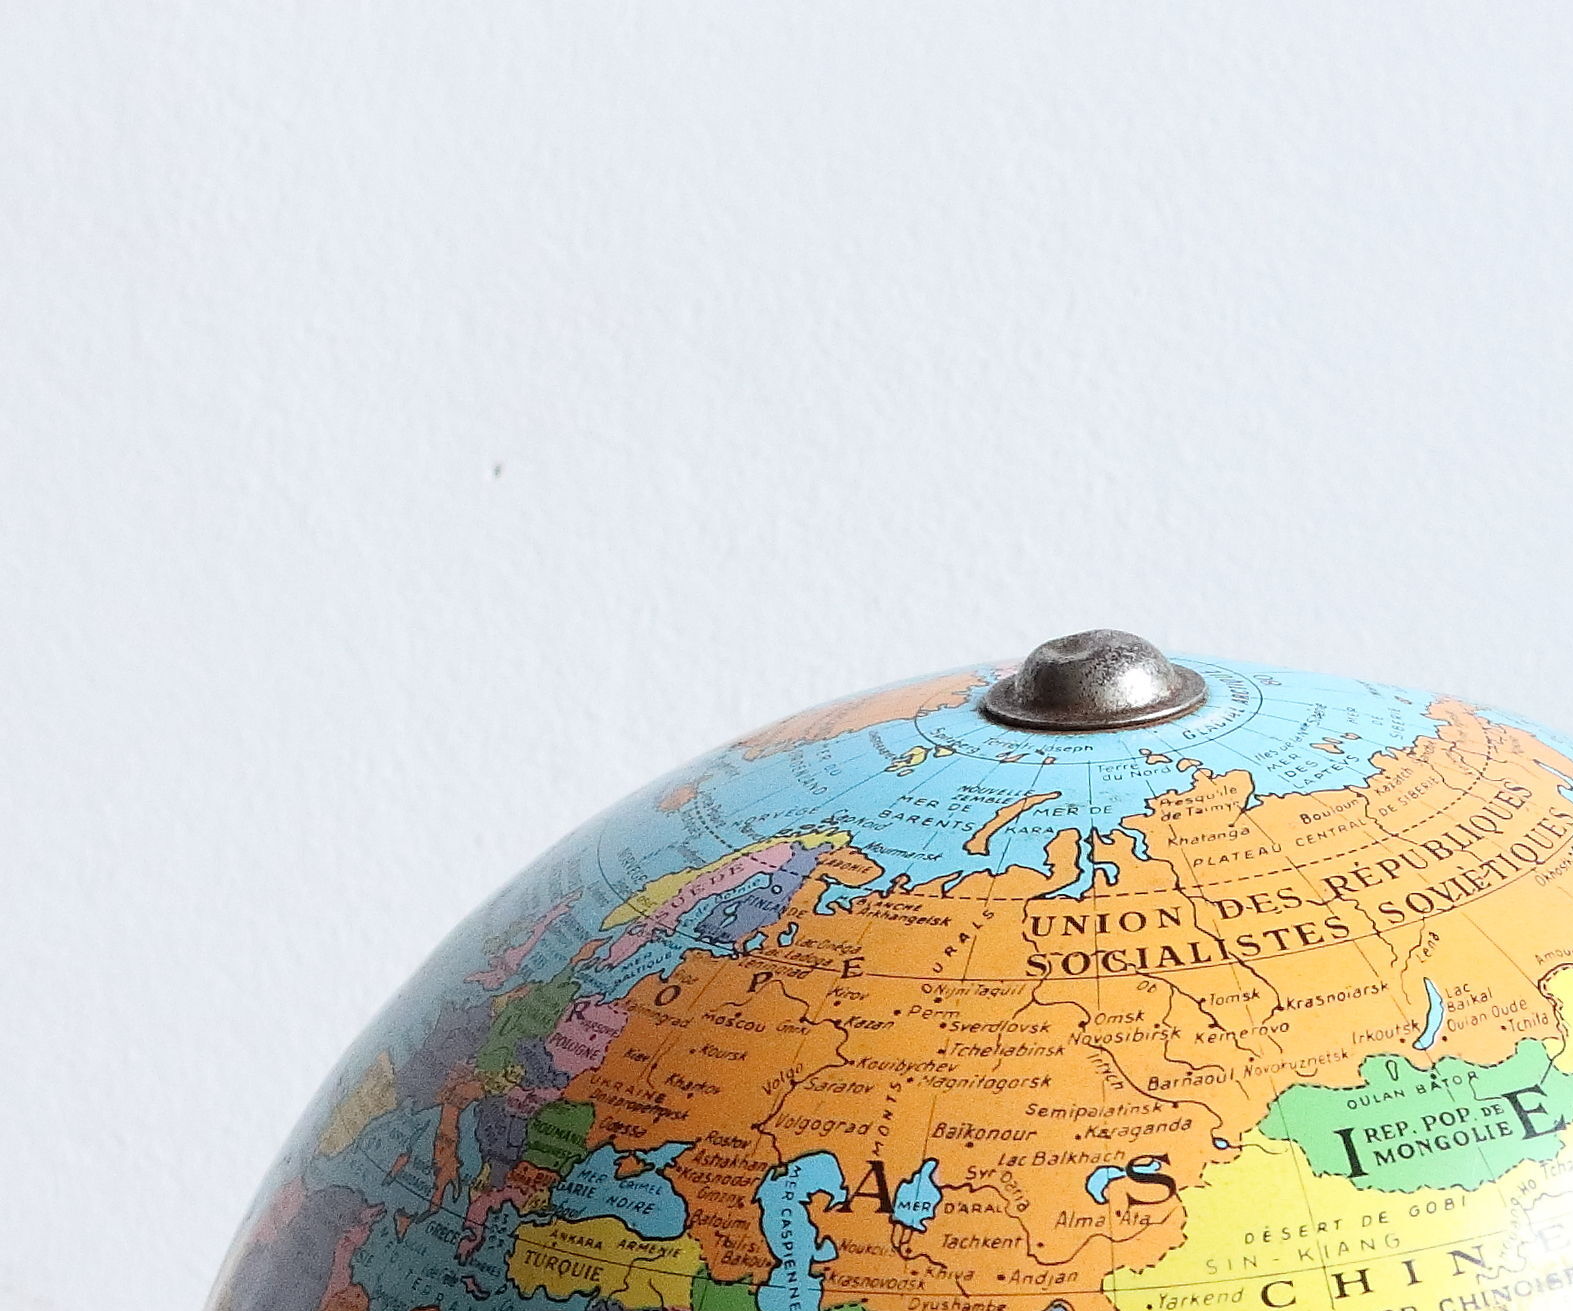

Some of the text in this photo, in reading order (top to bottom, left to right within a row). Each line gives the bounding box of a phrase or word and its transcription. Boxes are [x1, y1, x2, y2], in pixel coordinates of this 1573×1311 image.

[1032, 804, 1113, 817] MER DE
[1004, 826, 1055, 835] KARA
[1030, 777, 1536, 940] UNION DES RÉPUBLIQUES
[1025, 917, 1351, 978] SOCIALISTES
[1207, 989, 1261, 1007] Tomsk
[909, 1006, 959, 1018] Perm
[1094, 1010, 1146, 1026] Omsk
[948, 1020, 1051, 1034] Sverdlovsk
[1069, 1026, 1182, 1045] Novosibirsk
[1350, 1021, 1421, 1045] Irkoutsk
[1148, 1067, 1238, 1091] Barnaoul
[1026, 1101, 1165, 1118] Semipalatinsk
[775, 1114, 871, 1136] Volgograd
[1085, 1117, 1193, 1139] Karaganda
[1365, 1103, 1503, 1143] REP. POP. DE
[1373, 1121, 1515, 1166] MONGOLIE
[1362, 1210, 1390, 1229] DE
[1409, 1196, 1467, 1219] GOBI
[942, 1234, 1022, 1249] Tachkent
[523, 1250, 606, 1282] TURQUIE
